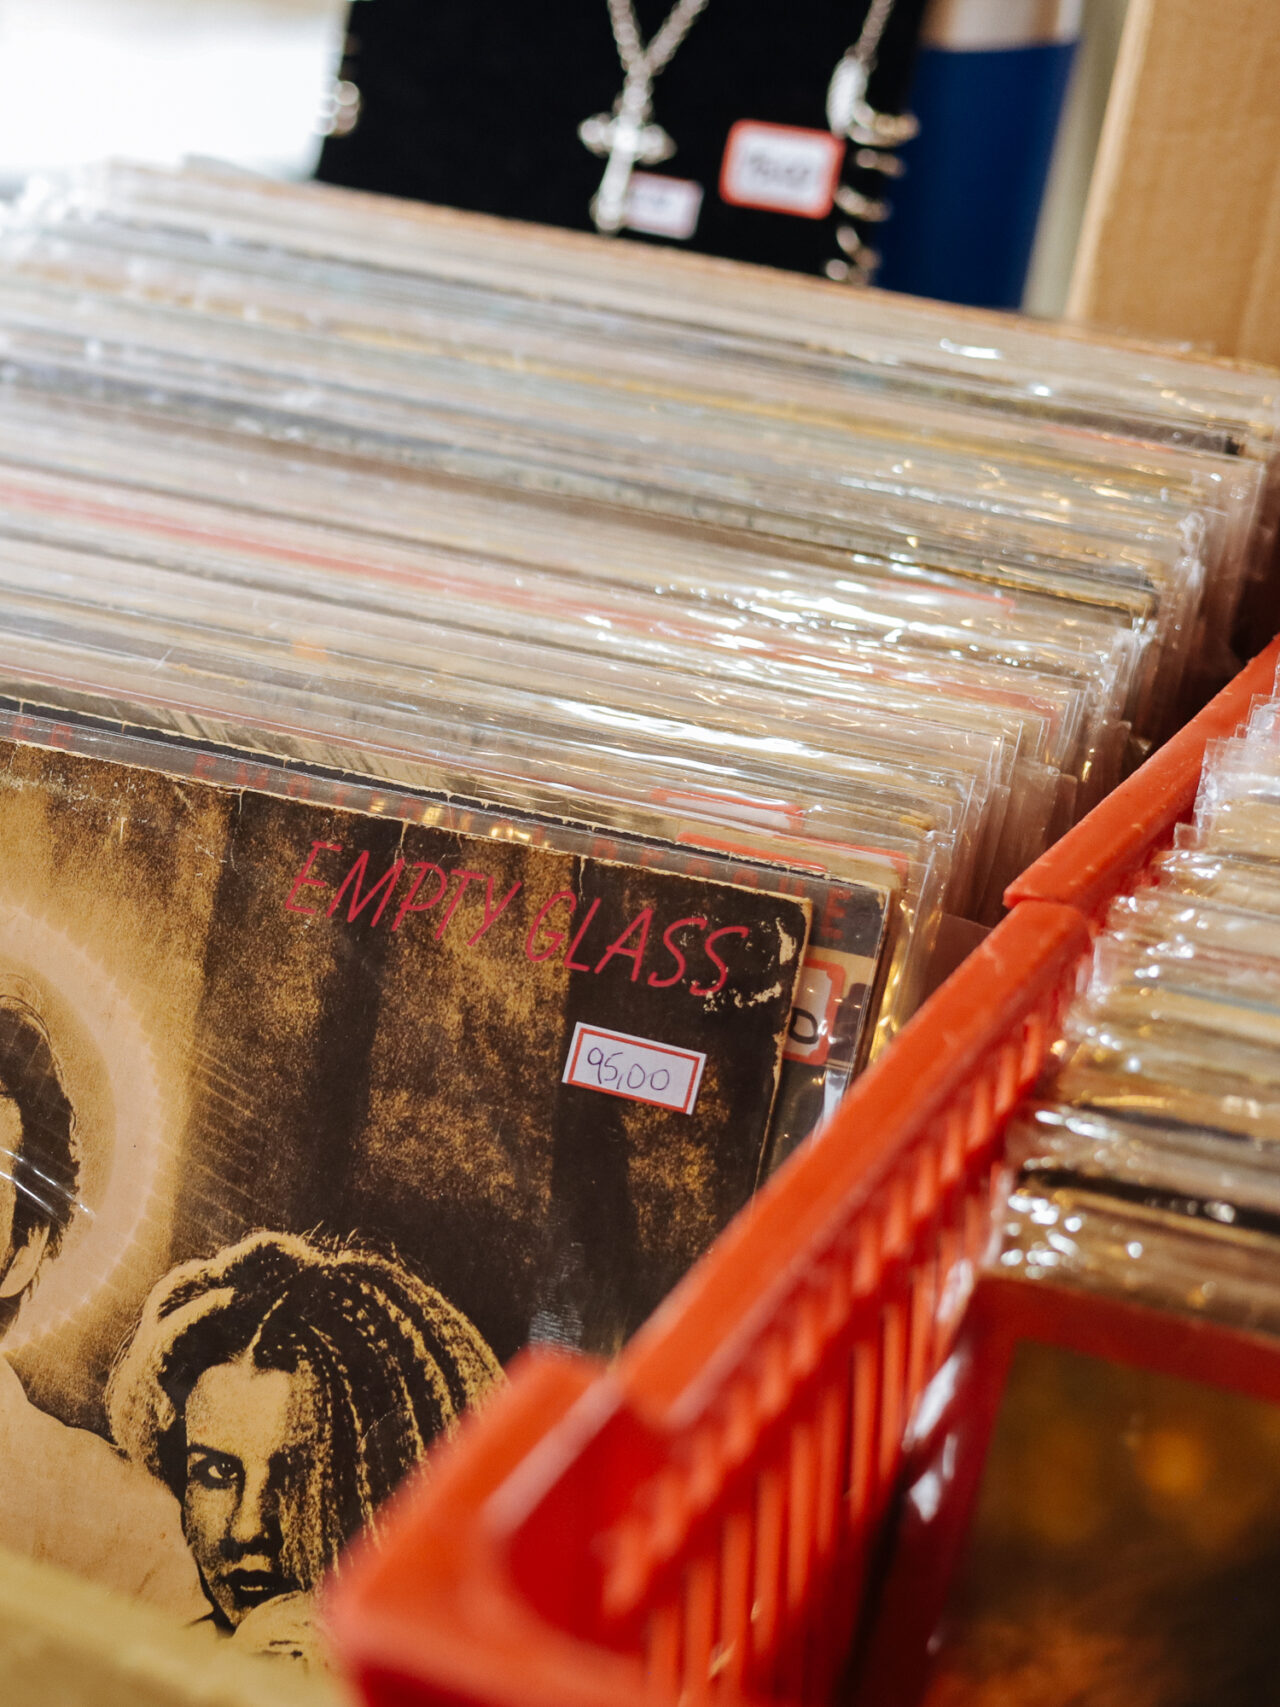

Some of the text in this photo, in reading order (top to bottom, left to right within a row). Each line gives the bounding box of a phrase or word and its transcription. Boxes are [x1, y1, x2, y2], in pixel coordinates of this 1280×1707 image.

[285, 840, 522, 946] EMPTY
[527, 891, 749, 997] GLASS
[587, 1046, 671, 1093] 95,00
